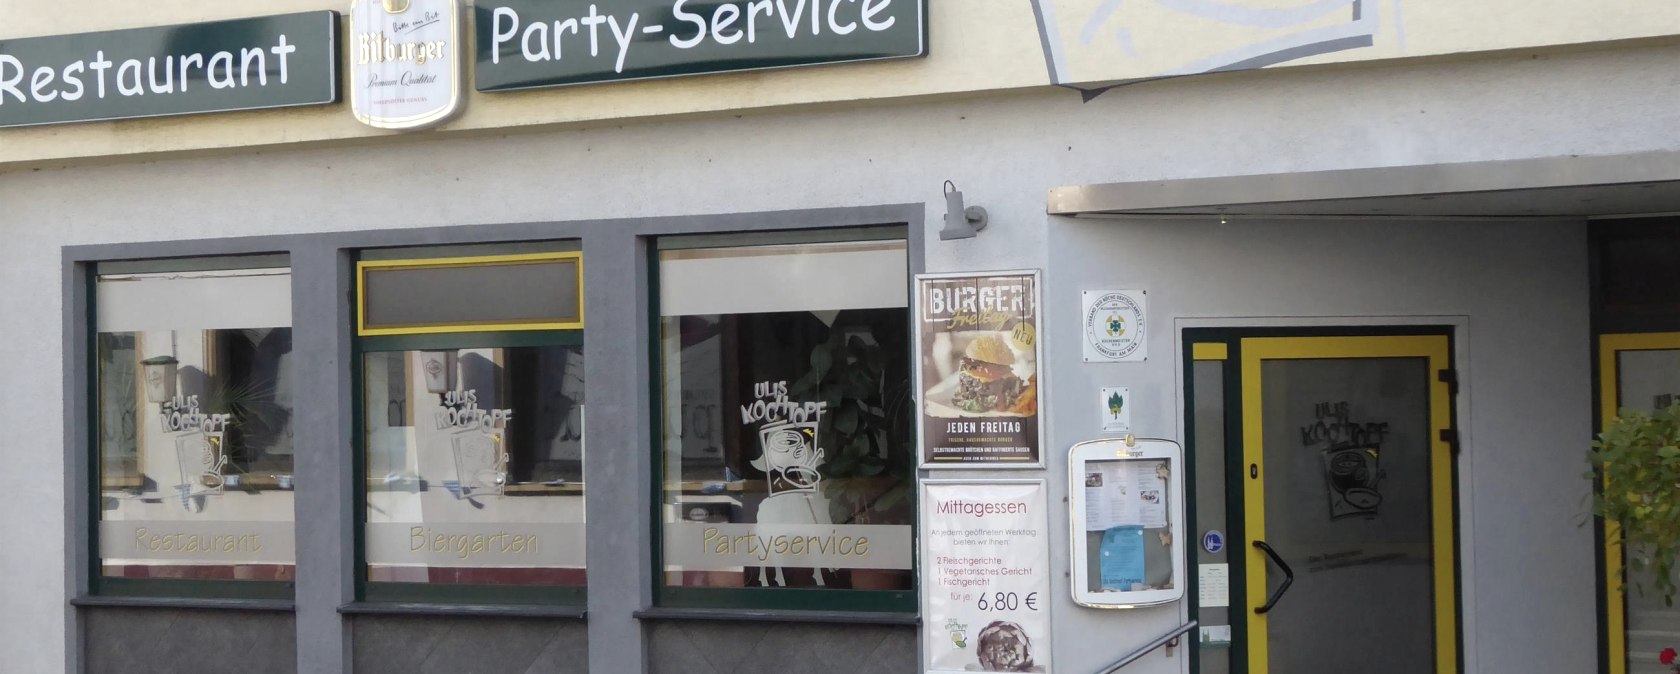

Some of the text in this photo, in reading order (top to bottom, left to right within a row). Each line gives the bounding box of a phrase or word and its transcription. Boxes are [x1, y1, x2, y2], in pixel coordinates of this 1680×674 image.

[492, 0, 896, 73] Party-Service
[358, 31, 446, 65] Bitburger
[0, 34, 296, 103] Restaurant
[366, 73, 397, 89] Premium
[930, 285, 1026, 313] BURGER
[1013, 328, 1034, 346] NEU
[445, 388, 477, 406] ULIS
[754, 380, 788, 399] ULIS
[172, 394, 199, 411] ULIS
[740, 395, 828, 428] KOCHTOPF
[1315, 401, 1349, 419] ULIS
[160, 407, 231, 433] KOCHTOPF
[435, 403, 512, 434] KOCHTOPF
[946, 421, 1021, 433] JEDEN FREITAG
[1300, 416, 1390, 447] KOCHTOPF
[936, 500, 1027, 517] Mittagessen
[135, 527, 263, 552] Restaurant
[953, 538, 976, 546] bieten
[964, 529, 1003, 537] geöffneten
[1005, 529, 1037, 537] Werktag
[410, 526, 538, 560] Biergarten
[703, 527, 869, 562] Partyservice
[937, 556, 1002, 567] 2 Fleischgerichte
[943, 567, 999, 576] Vegetarisches
[1001, 567, 1032, 576] Gericht
[943, 578, 990, 587] Fischgericht
[950, 592, 961, 601] für
[977, 592, 1019, 612] 6,80
[1025, 591, 1038, 611] €
